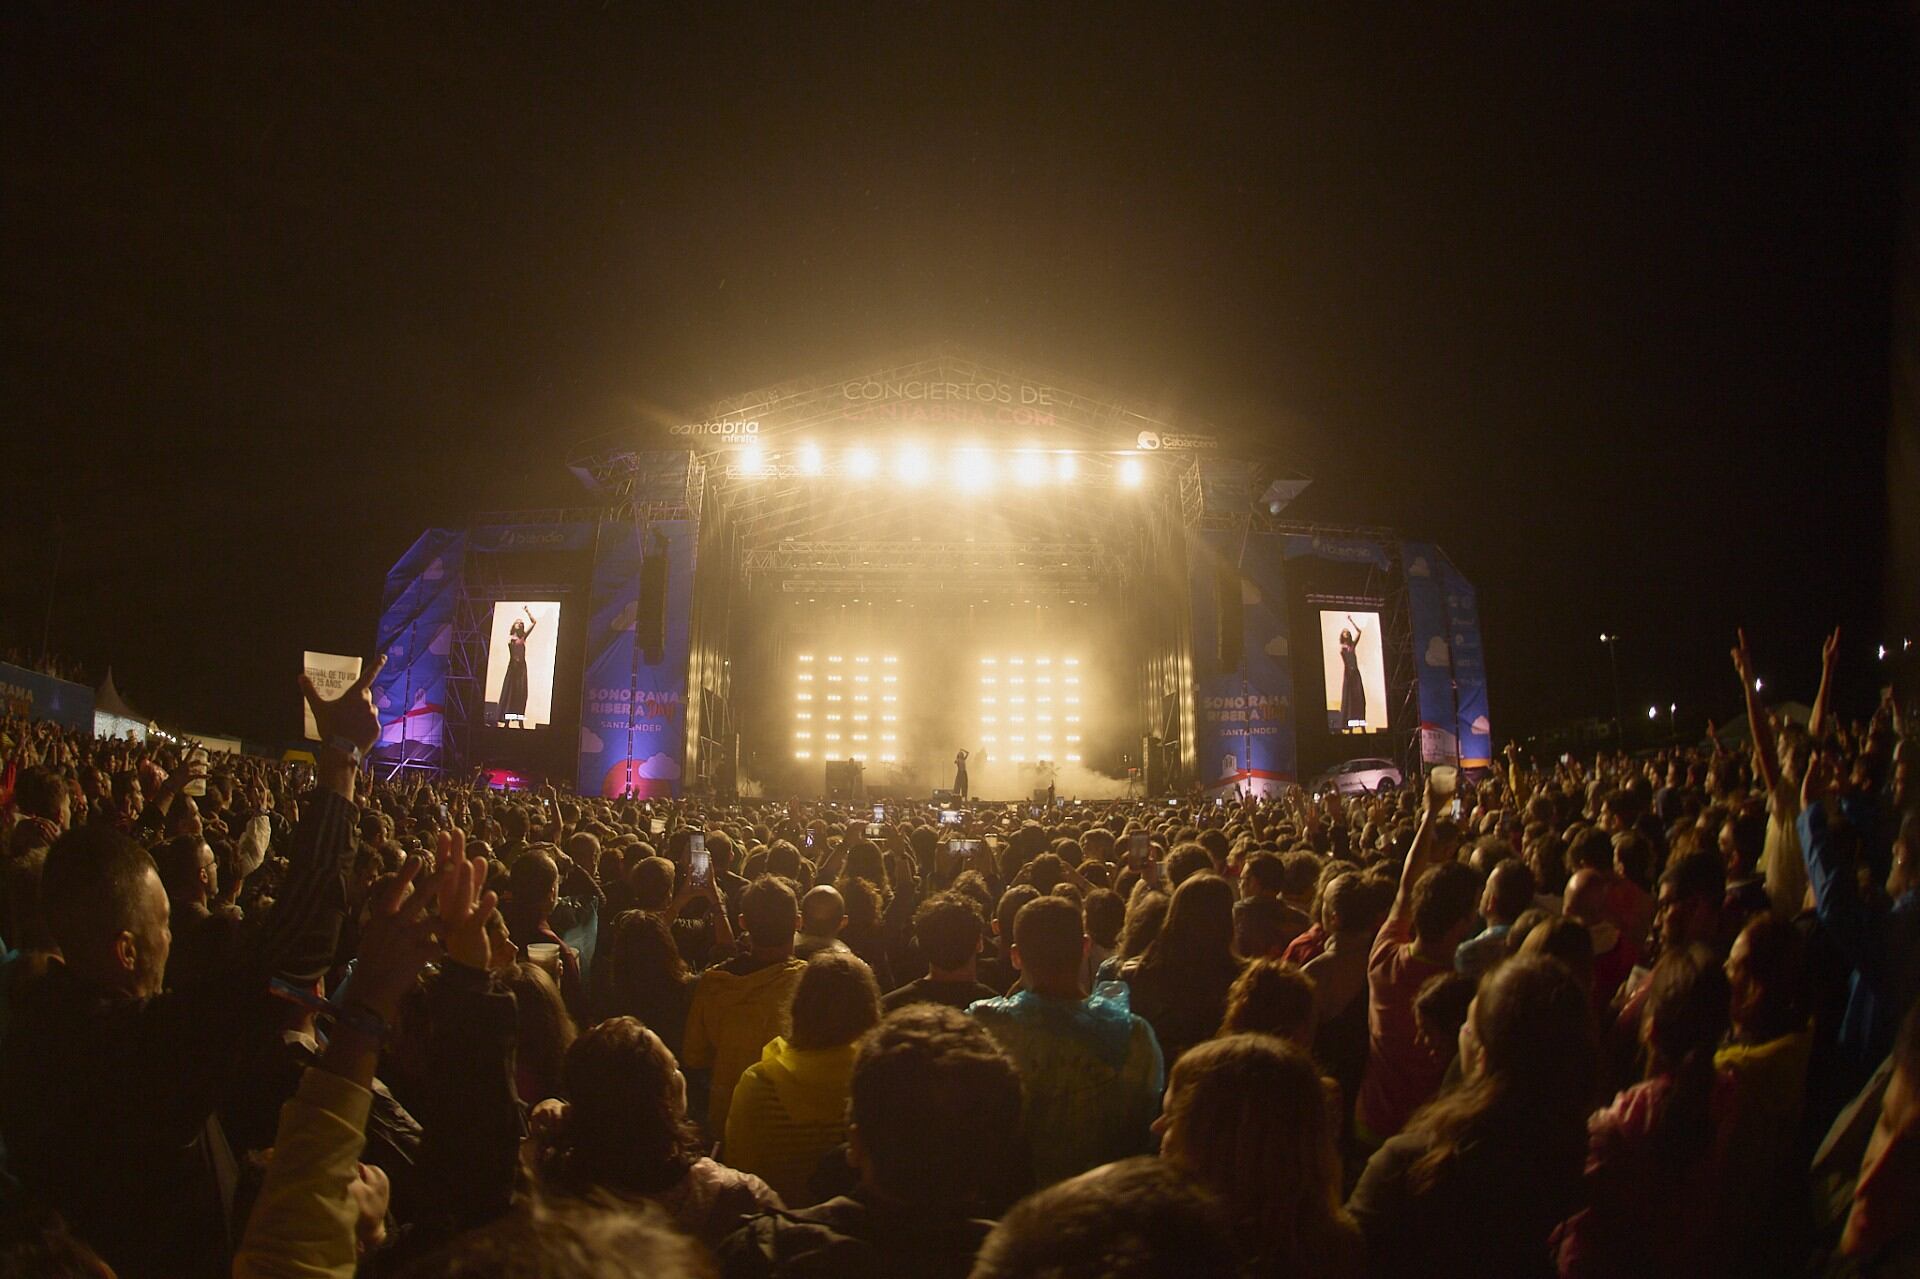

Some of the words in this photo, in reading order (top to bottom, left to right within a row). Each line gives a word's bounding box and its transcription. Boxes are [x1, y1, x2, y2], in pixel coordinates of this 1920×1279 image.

[842, 381, 1012, 403] CONCIERTOS
[1020, 385, 1053, 406] DE
[669, 418, 760, 435] cantabria
[600, 720, 663, 732] SANTANDER
